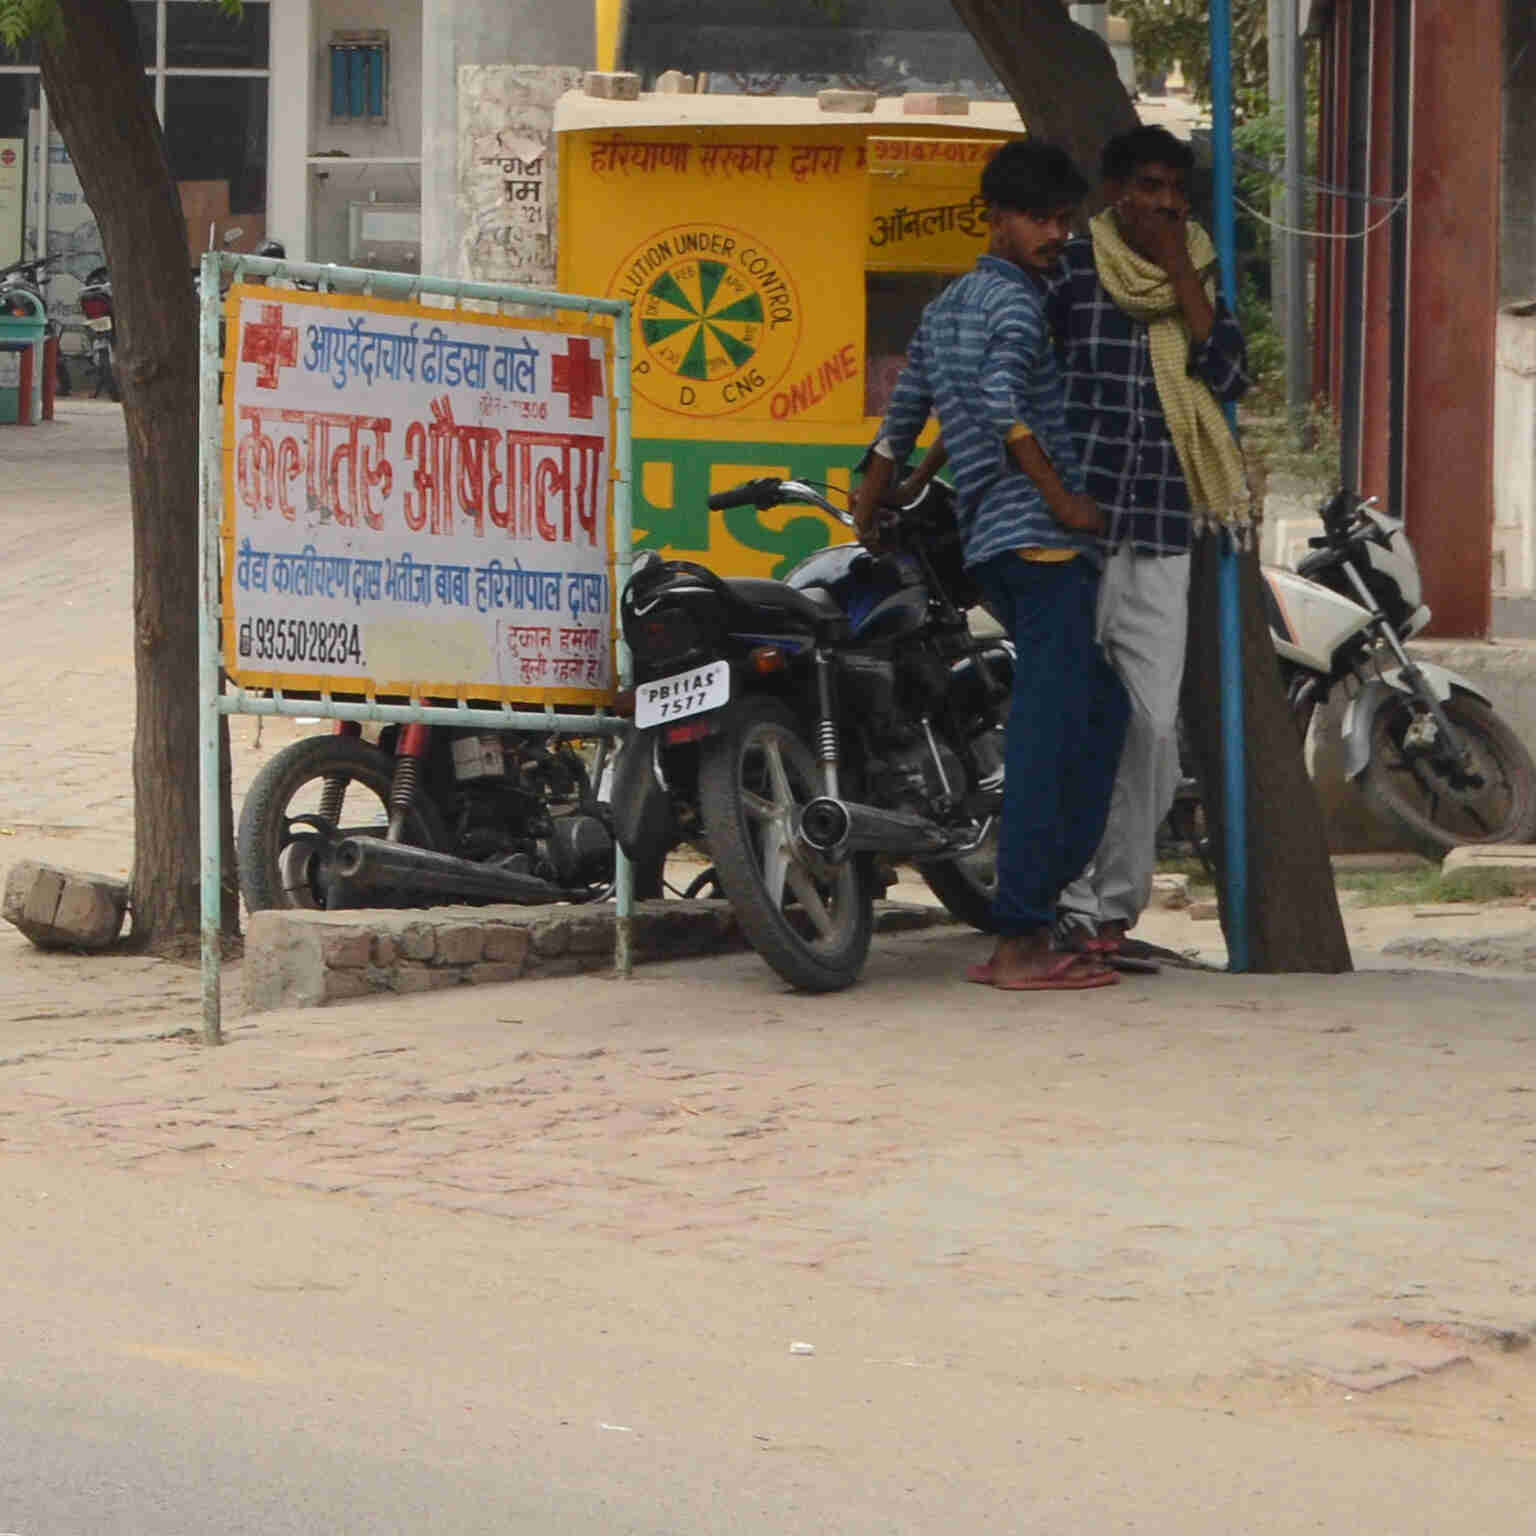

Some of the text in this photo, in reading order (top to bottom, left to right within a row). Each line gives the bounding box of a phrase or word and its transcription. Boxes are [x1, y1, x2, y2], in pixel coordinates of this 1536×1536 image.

[589, 134, 693, 178] हरियाणा
[673, 231, 736, 259] UNDER
[739, 247, 795, 331] CONTROL
[493, 336, 539, 395] वाले
[721, 370, 766, 405] CNG
[769, 342, 858, 422] ONLINE
[403, 394, 605, 547] औषधालय
[434, 563, 471, 608] बाबा
